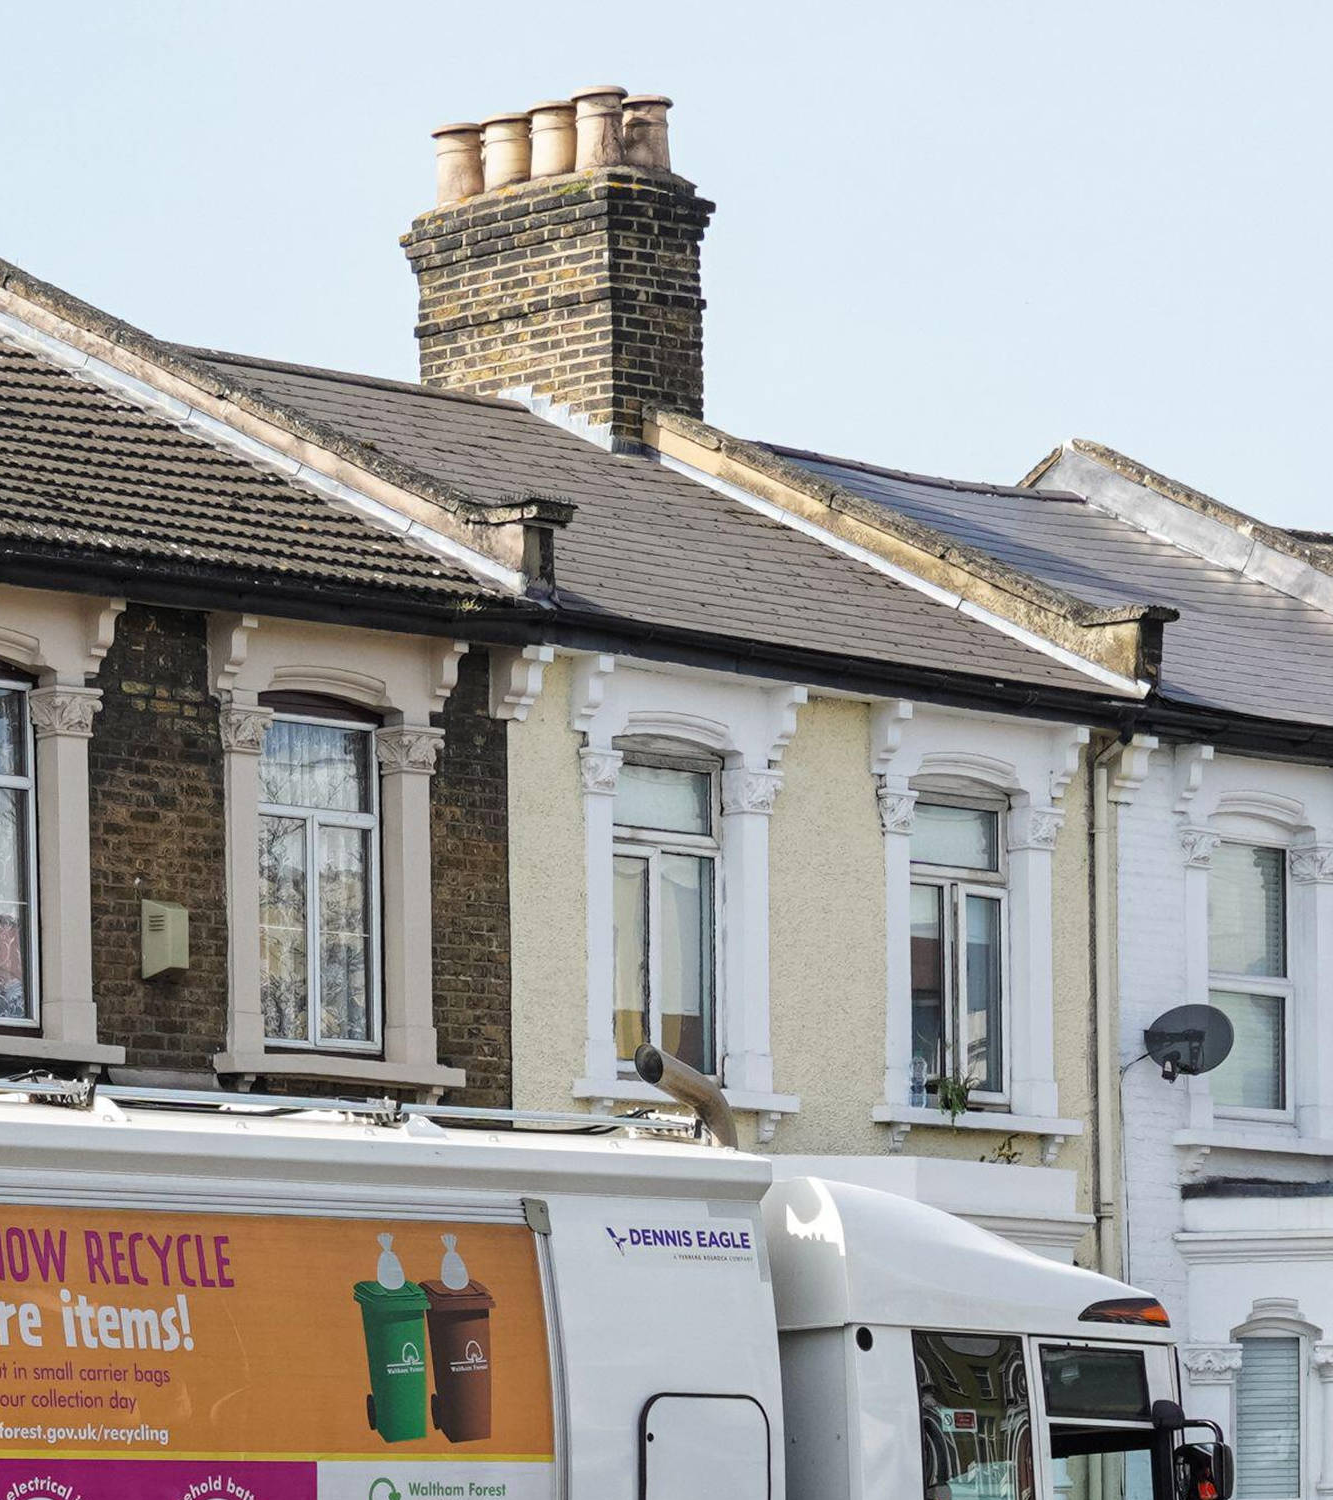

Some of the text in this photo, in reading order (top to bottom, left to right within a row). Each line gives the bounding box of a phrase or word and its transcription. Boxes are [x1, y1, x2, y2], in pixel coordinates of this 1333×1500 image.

[629, 1228, 751, 1250] DENNIS EAGLE
[84, 1230, 235, 1288] RECYCLE
[59, 1288, 195, 1352] items!
[13, 1361, 27, 1379] in
[33, 1360, 73, 1381] small
[79, 1363, 129, 1382] carrier
[135, 1363, 171, 1387] bags
[31, 1389, 103, 1409] collection
[110, 1390, 137, 1414] day
[408, 1481, 506, 1497] Waltham Forest
